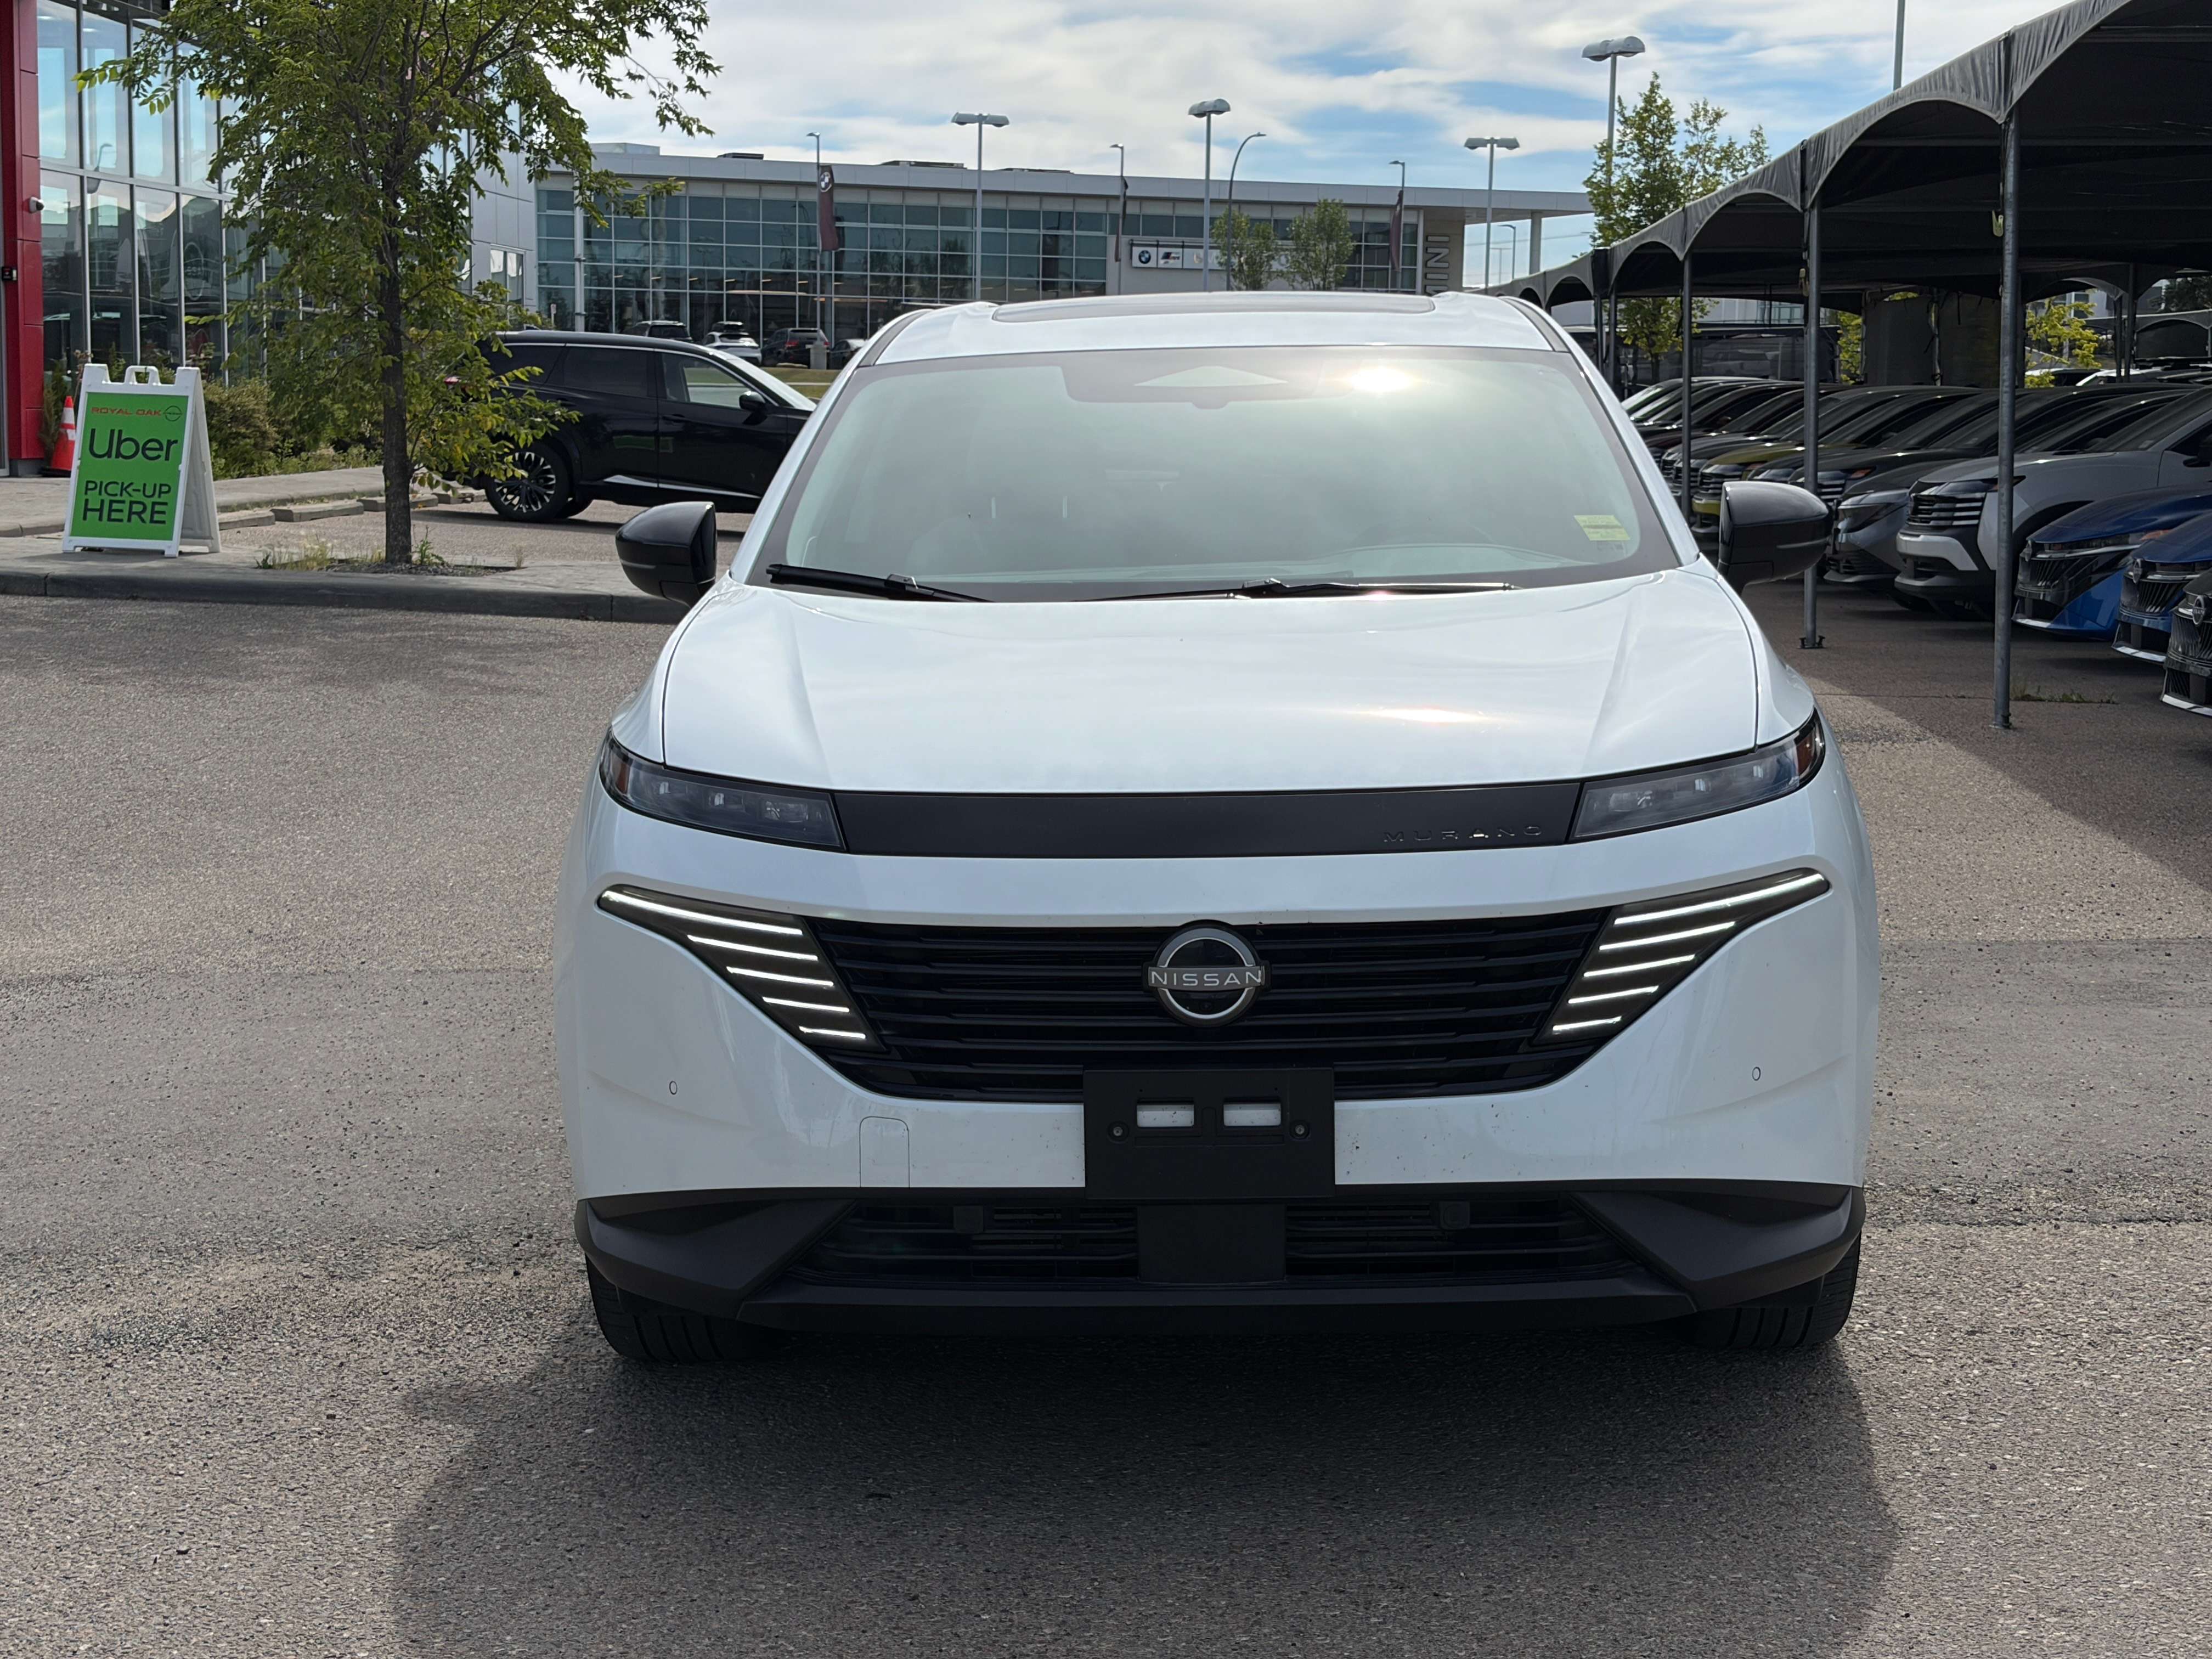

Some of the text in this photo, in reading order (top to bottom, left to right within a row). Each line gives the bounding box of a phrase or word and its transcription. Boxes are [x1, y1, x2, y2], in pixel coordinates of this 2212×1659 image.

[91, 407, 132, 415] ROYAL
[89, 428, 178, 461] Uber
[84, 480, 171, 499] PICK-UP
[83, 498, 168, 524] HERE
[1383, 826, 1542, 843] MURANO
[1152, 969, 1261, 986] NISSAN
